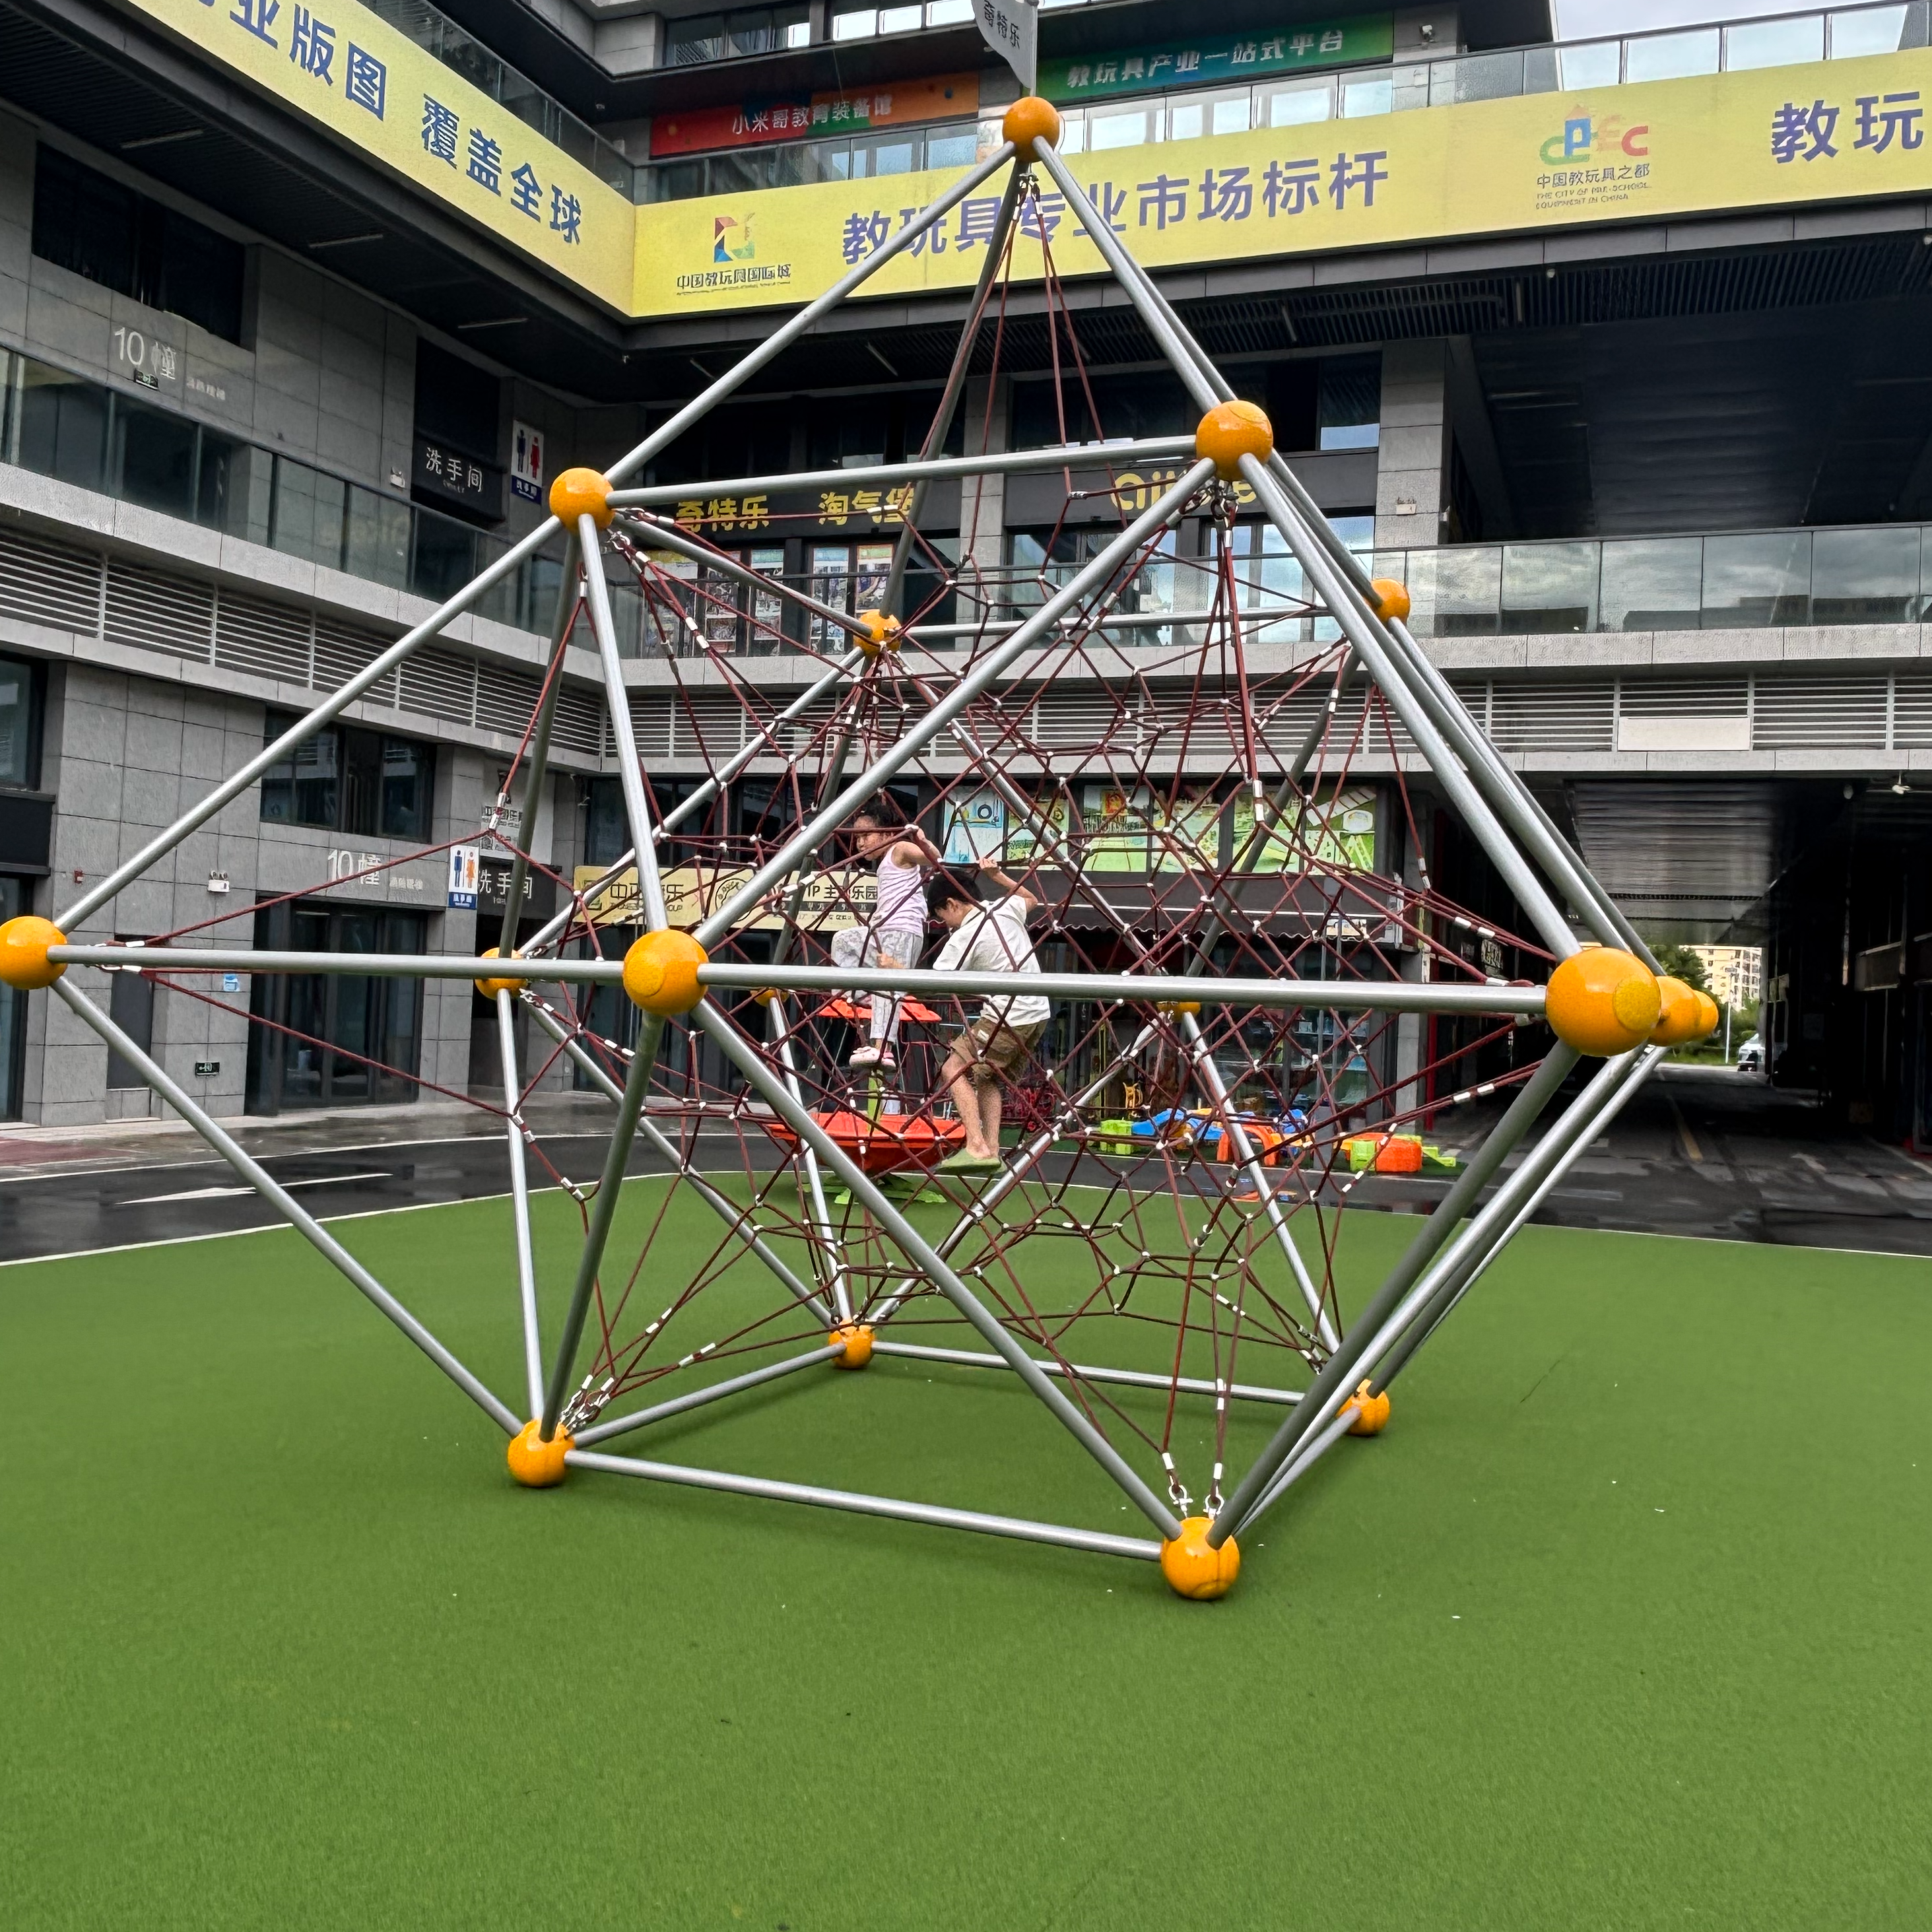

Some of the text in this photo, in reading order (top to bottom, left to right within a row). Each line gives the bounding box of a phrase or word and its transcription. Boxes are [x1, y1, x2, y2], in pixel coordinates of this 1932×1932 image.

[201, 0, 581, 245] 业版图 覆盖全球
[1772, 91, 1923, 164] 教玩
[842, 150, 1389, 264] 教玩具专业市场标杆
[675, 487, 915, 533] 奇特乐 淘气堡
